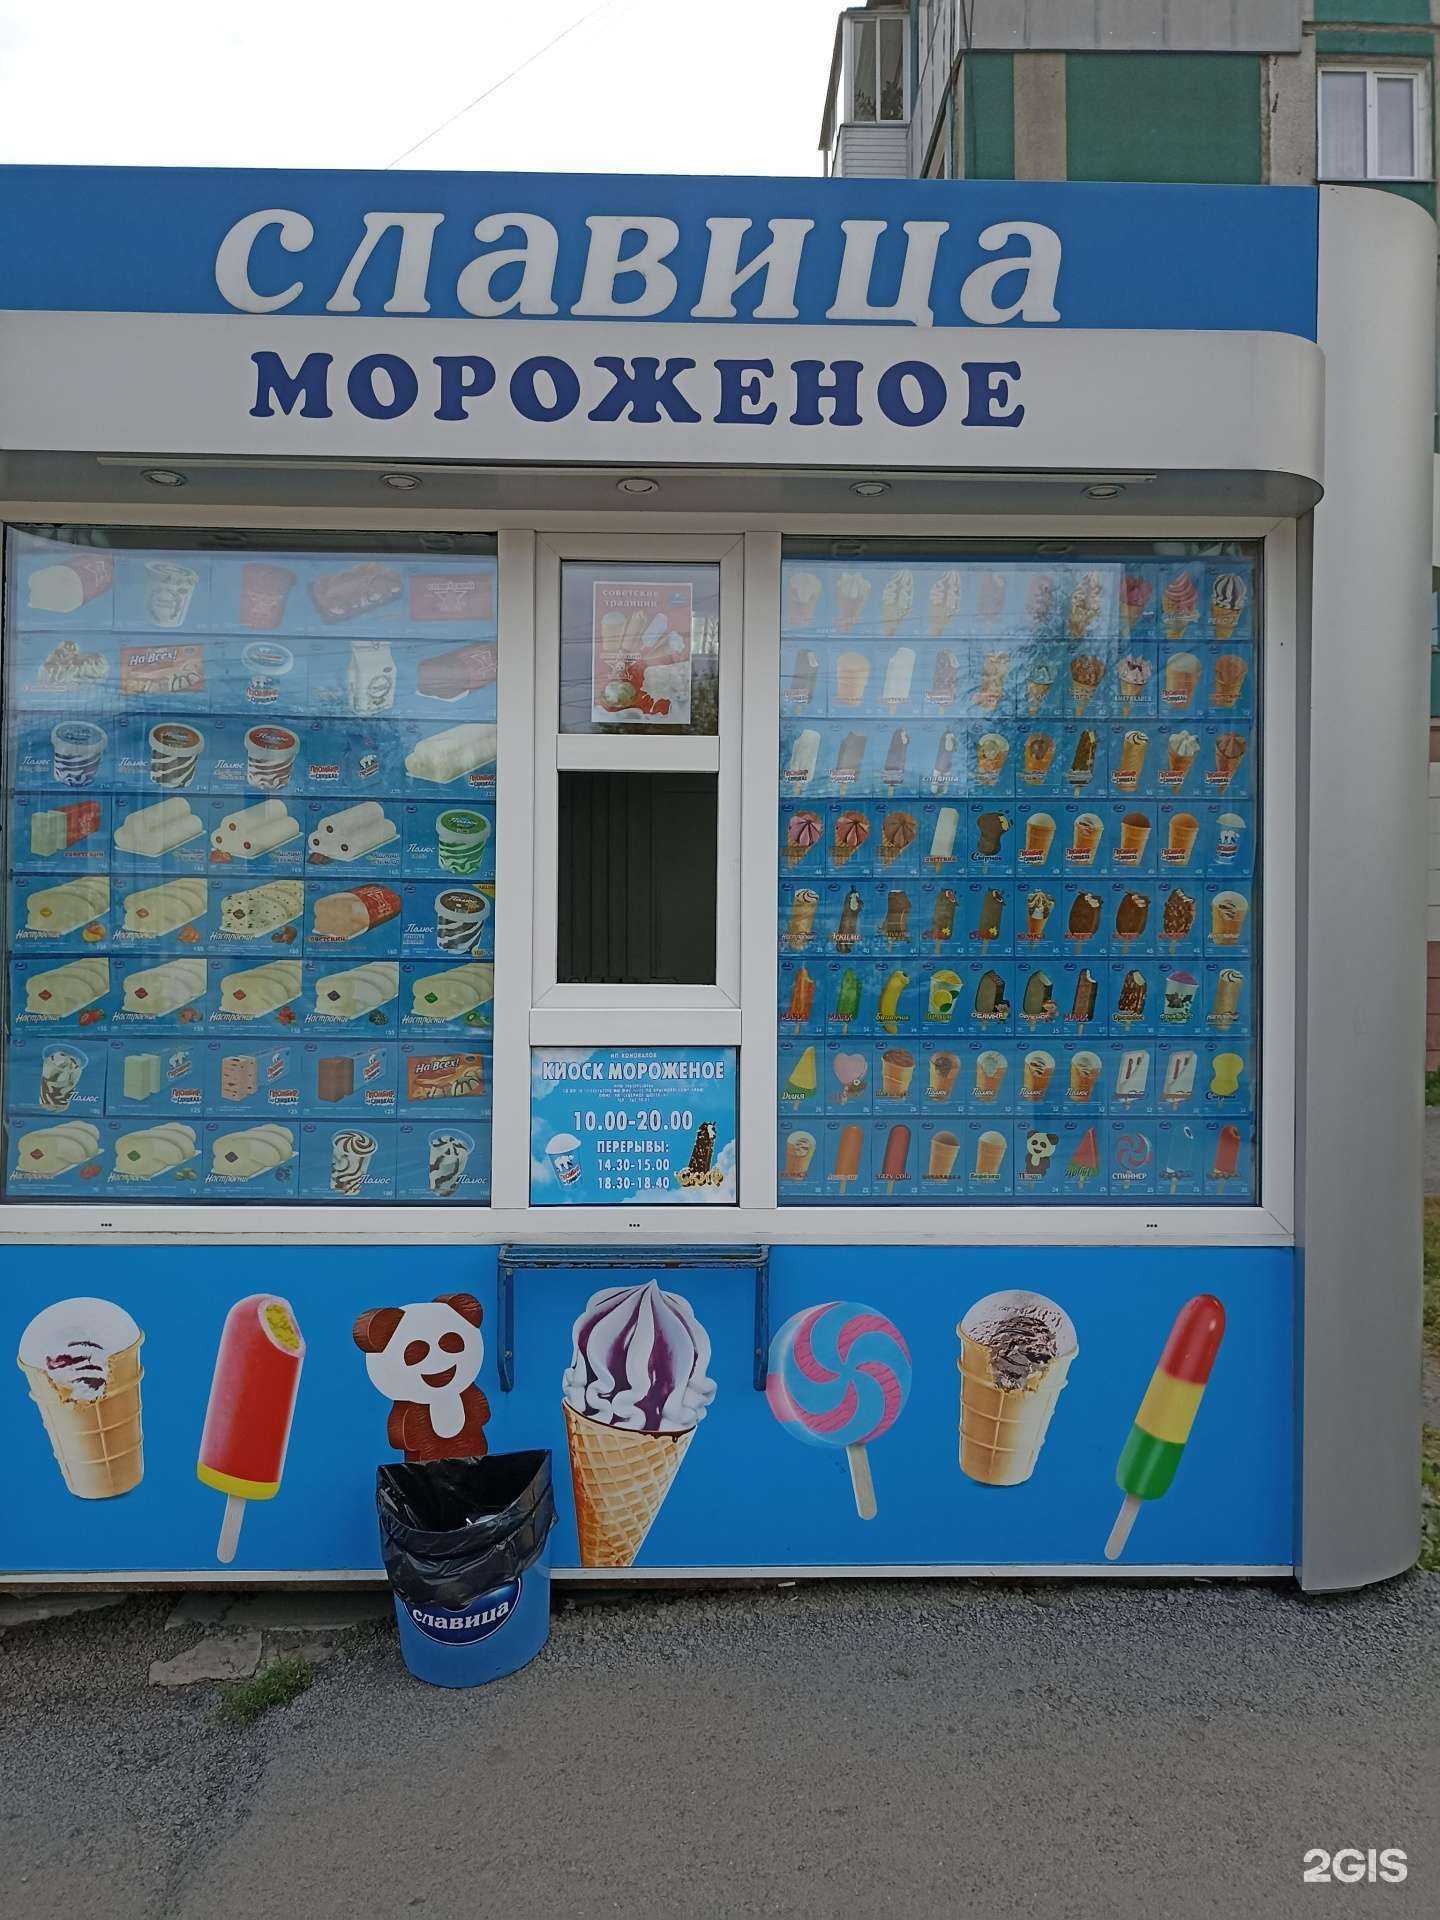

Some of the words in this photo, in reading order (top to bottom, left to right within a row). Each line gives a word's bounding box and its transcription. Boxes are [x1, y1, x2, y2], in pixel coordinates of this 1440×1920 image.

[249, 350, 1026, 428] МОРОЖЕНОЕ
[543, 1061, 604, 1080] КИОСК
[608, 1061, 724, 1080] МОРОЖЕНОЕ
[573, 1110, 694, 1131] 10.00-20.00
[596, 1140, 669, 1154] ПЕРЕРЫВЫ:
[598, 1158, 670, 1171] 14.30-15.00
[598, 1176, 670, 1189] 18.30-18.40
